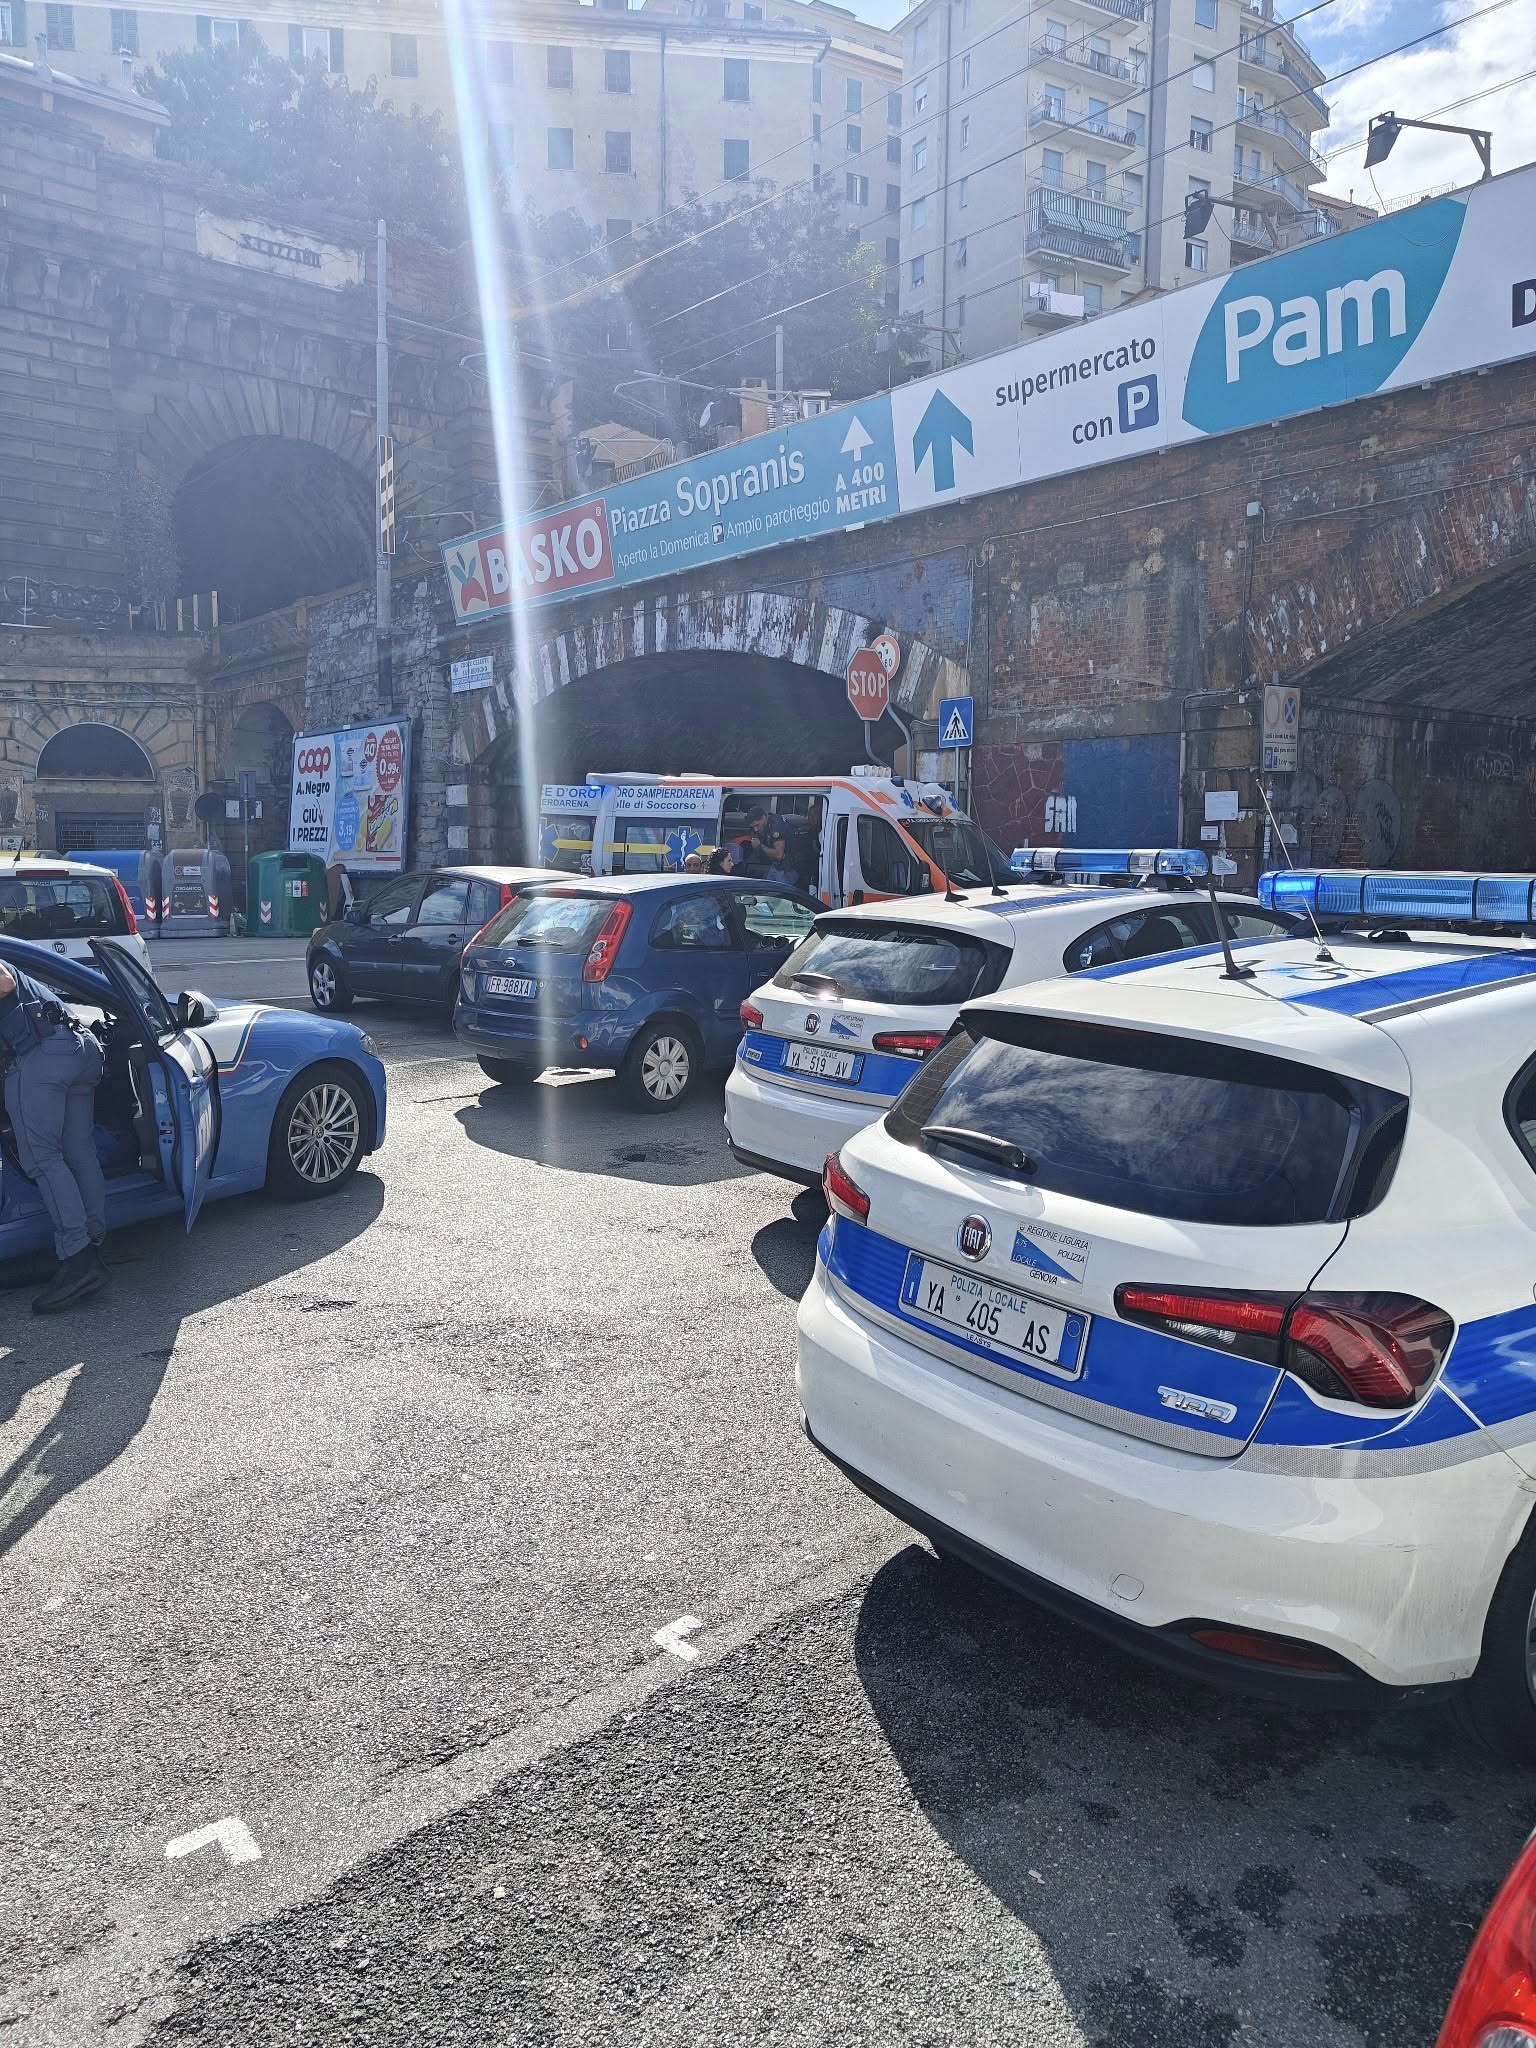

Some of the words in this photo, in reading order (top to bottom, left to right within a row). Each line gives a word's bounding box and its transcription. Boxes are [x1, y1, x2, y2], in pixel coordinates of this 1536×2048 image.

[1224, 269, 1406, 384] Pam
[995, 338, 1156, 407] supermercato
[1072, 416, 1113, 445] con
[610, 500, 671, 536] Piazza
[676, 444, 806, 517] Sopranis
[835, 473, 847, 492] A
[851, 461, 885, 486] 400
[836, 484, 887, 514] METRI
[617, 547, 648, 568] Aperto
[649, 542, 658, 559] la
[660, 532, 709, 556] Domenica
[726, 517, 762, 538] Ampio
[765, 496, 830, 530] parcheggio
[486, 518, 603, 595] BASKO
[850, 670, 886, 698] STOP
[633, 800, 643, 809] di
[646, 800, 697, 810] Soccorso
[636, 788, 715, 799] SAMPIERDARENA
[302, 804, 318, 823] GIÙ
[297, 826, 328, 842] PREZZI
[491, 977, 502, 992] FR
[791, 1051, 800, 1067] YA
[810, 1056, 827, 1072] 519
[834, 1061, 849, 1077] AV
[963, 1226, 984, 1250] FIAT
[1027, 1225, 1058, 1241] REGIONE
[1058, 1234, 1089, 1250] LIGURIA
[1012, 1254, 1037, 1268] LOCALE
[1057, 1249, 1085, 1264] POLIZIA
[1029, 1269, 1058, 1285] GENOVA
[951, 1274, 983, 1298] POLIZIA
[989, 1288, 1028, 1314] LOCALE
[927, 1280, 945, 1314] YA
[966, 1300, 1002, 1335] 405
[1021, 1320, 1050, 1354] AS
[1157, 1384, 1238, 1424] TIPO
